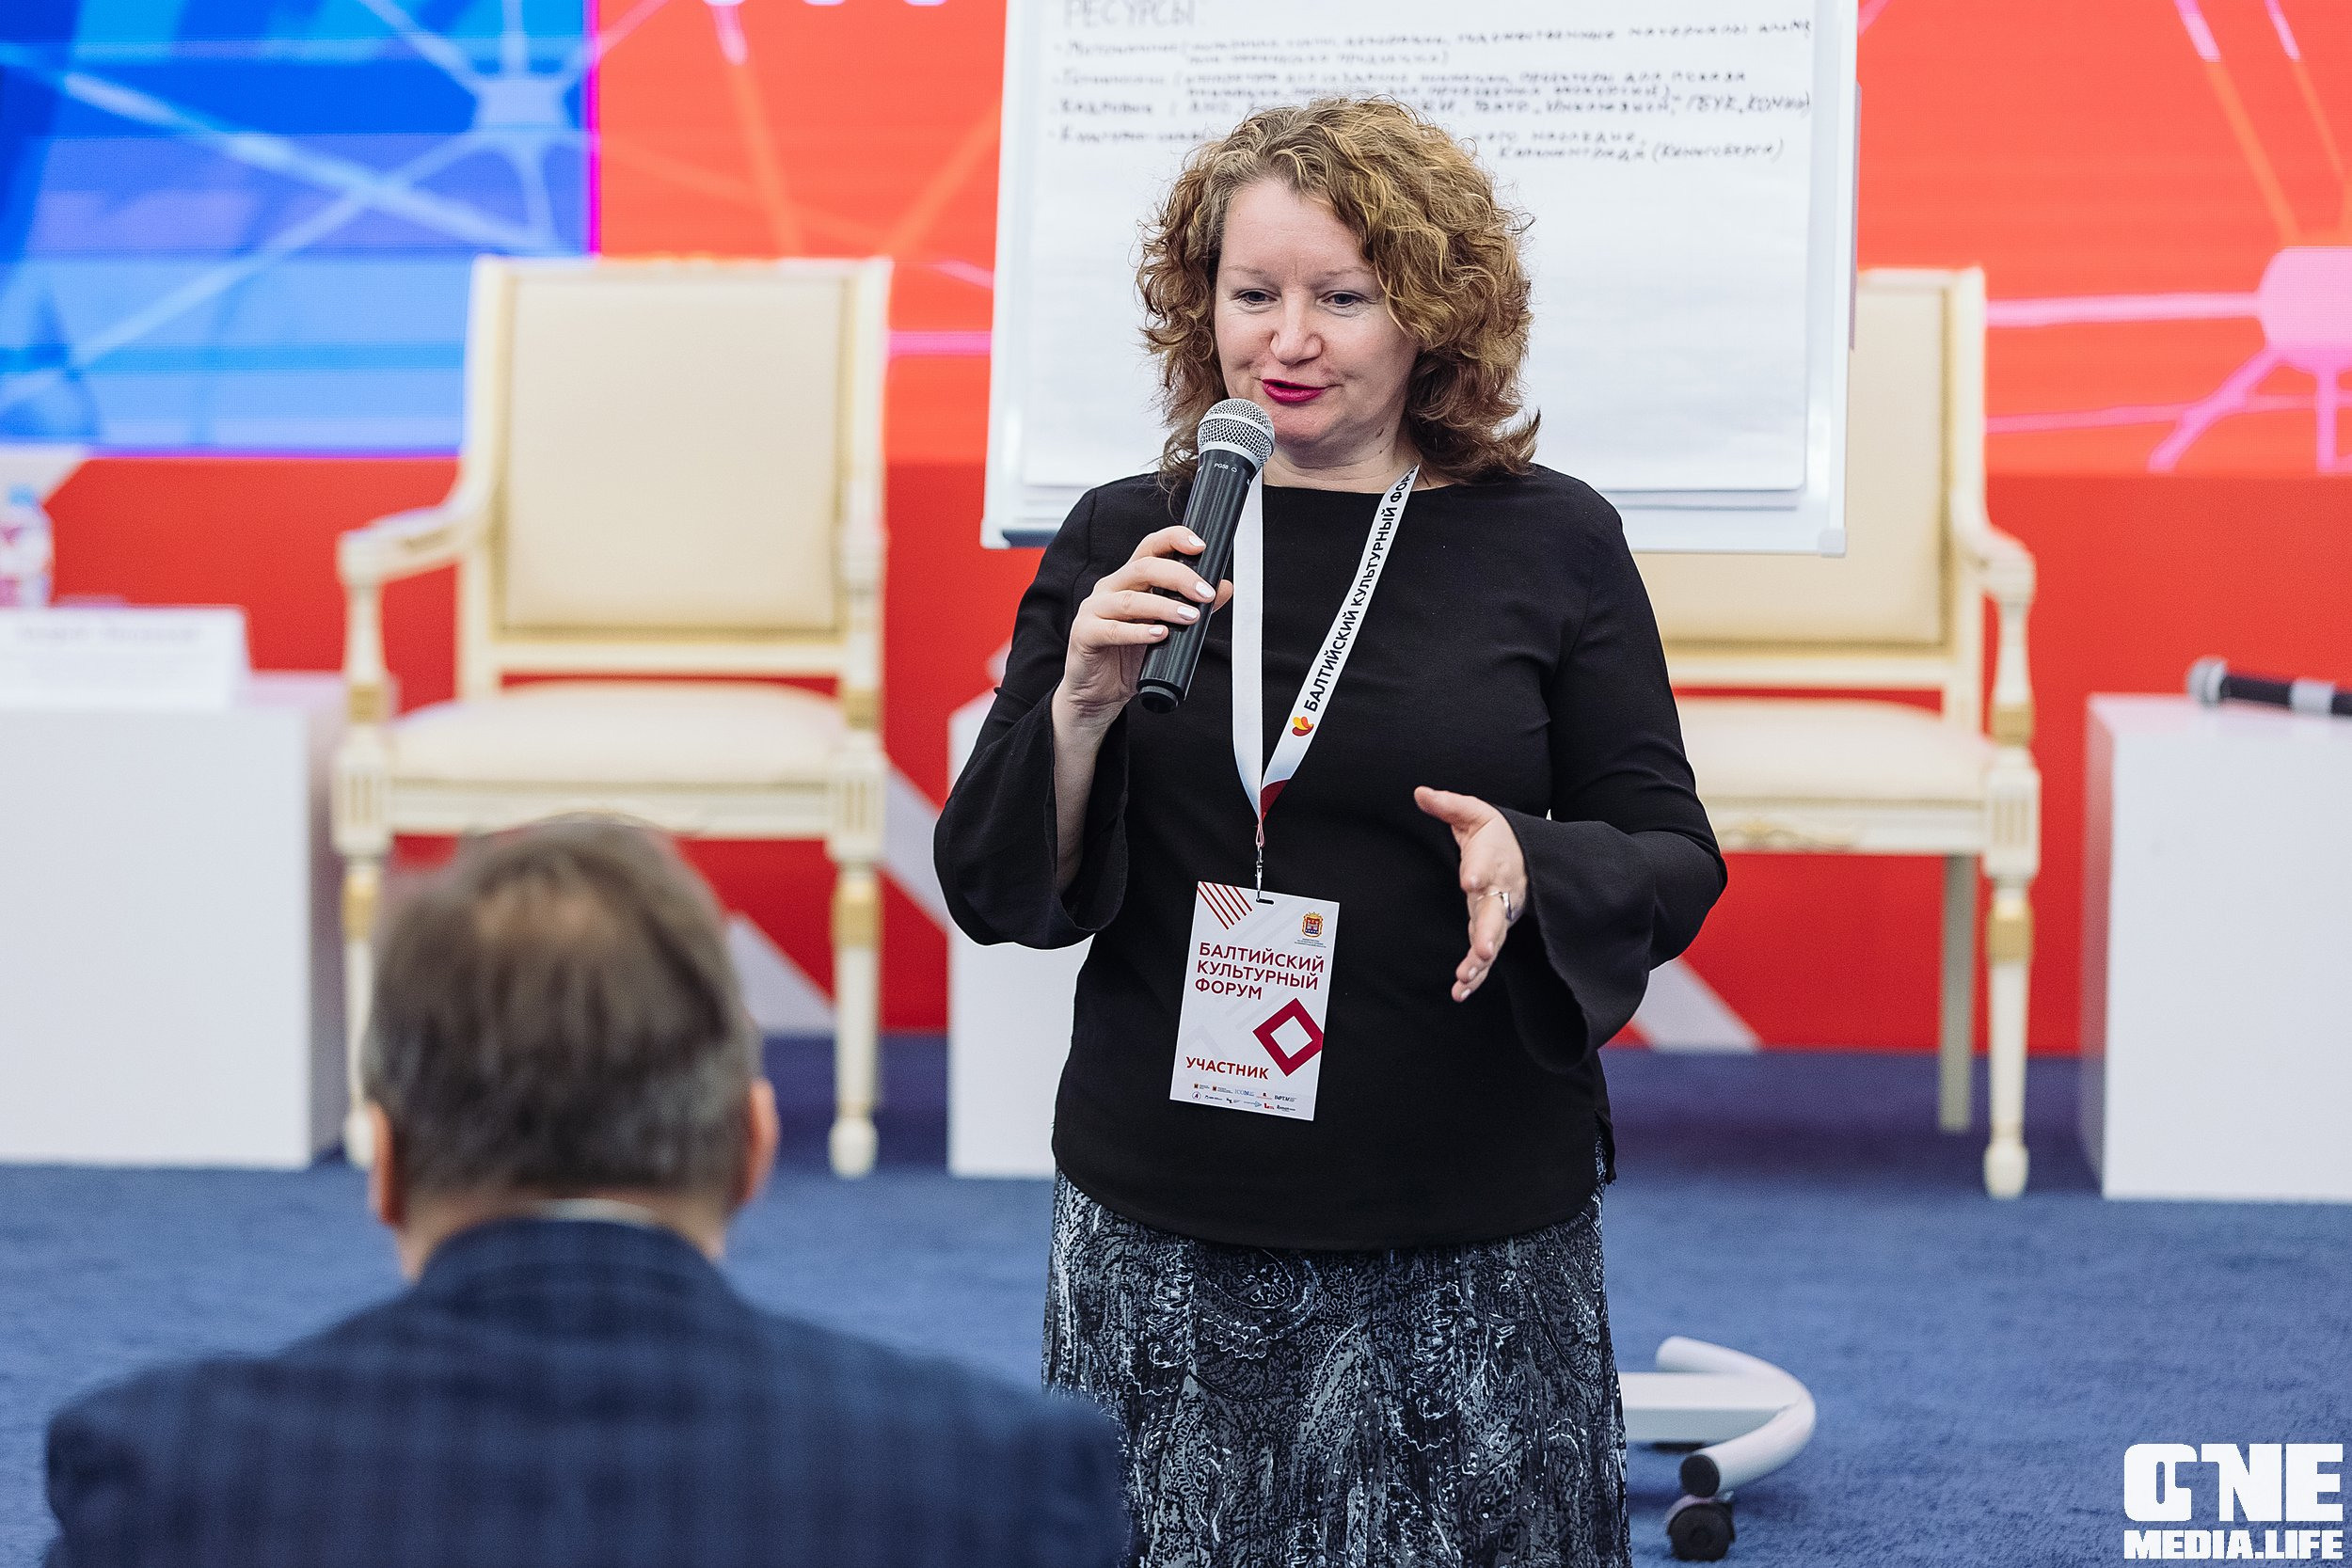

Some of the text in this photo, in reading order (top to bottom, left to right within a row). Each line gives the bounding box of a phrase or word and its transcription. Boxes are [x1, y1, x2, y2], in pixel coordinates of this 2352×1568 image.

[1303, 610, 1359, 713] БАЛТИЙСКИЙ
[1351, 506, 1398, 607] КУЛЬТУРНЫЙ
[1199, 942, 1325, 974] БАЛТИЙСКИЙ
[1195, 977, 1263, 1001] ФОРУМ
[1196, 959, 1319, 990] КУЛЬТУРНЫЙ
[1185, 1056, 1269, 1080] УЧАСТНИК
